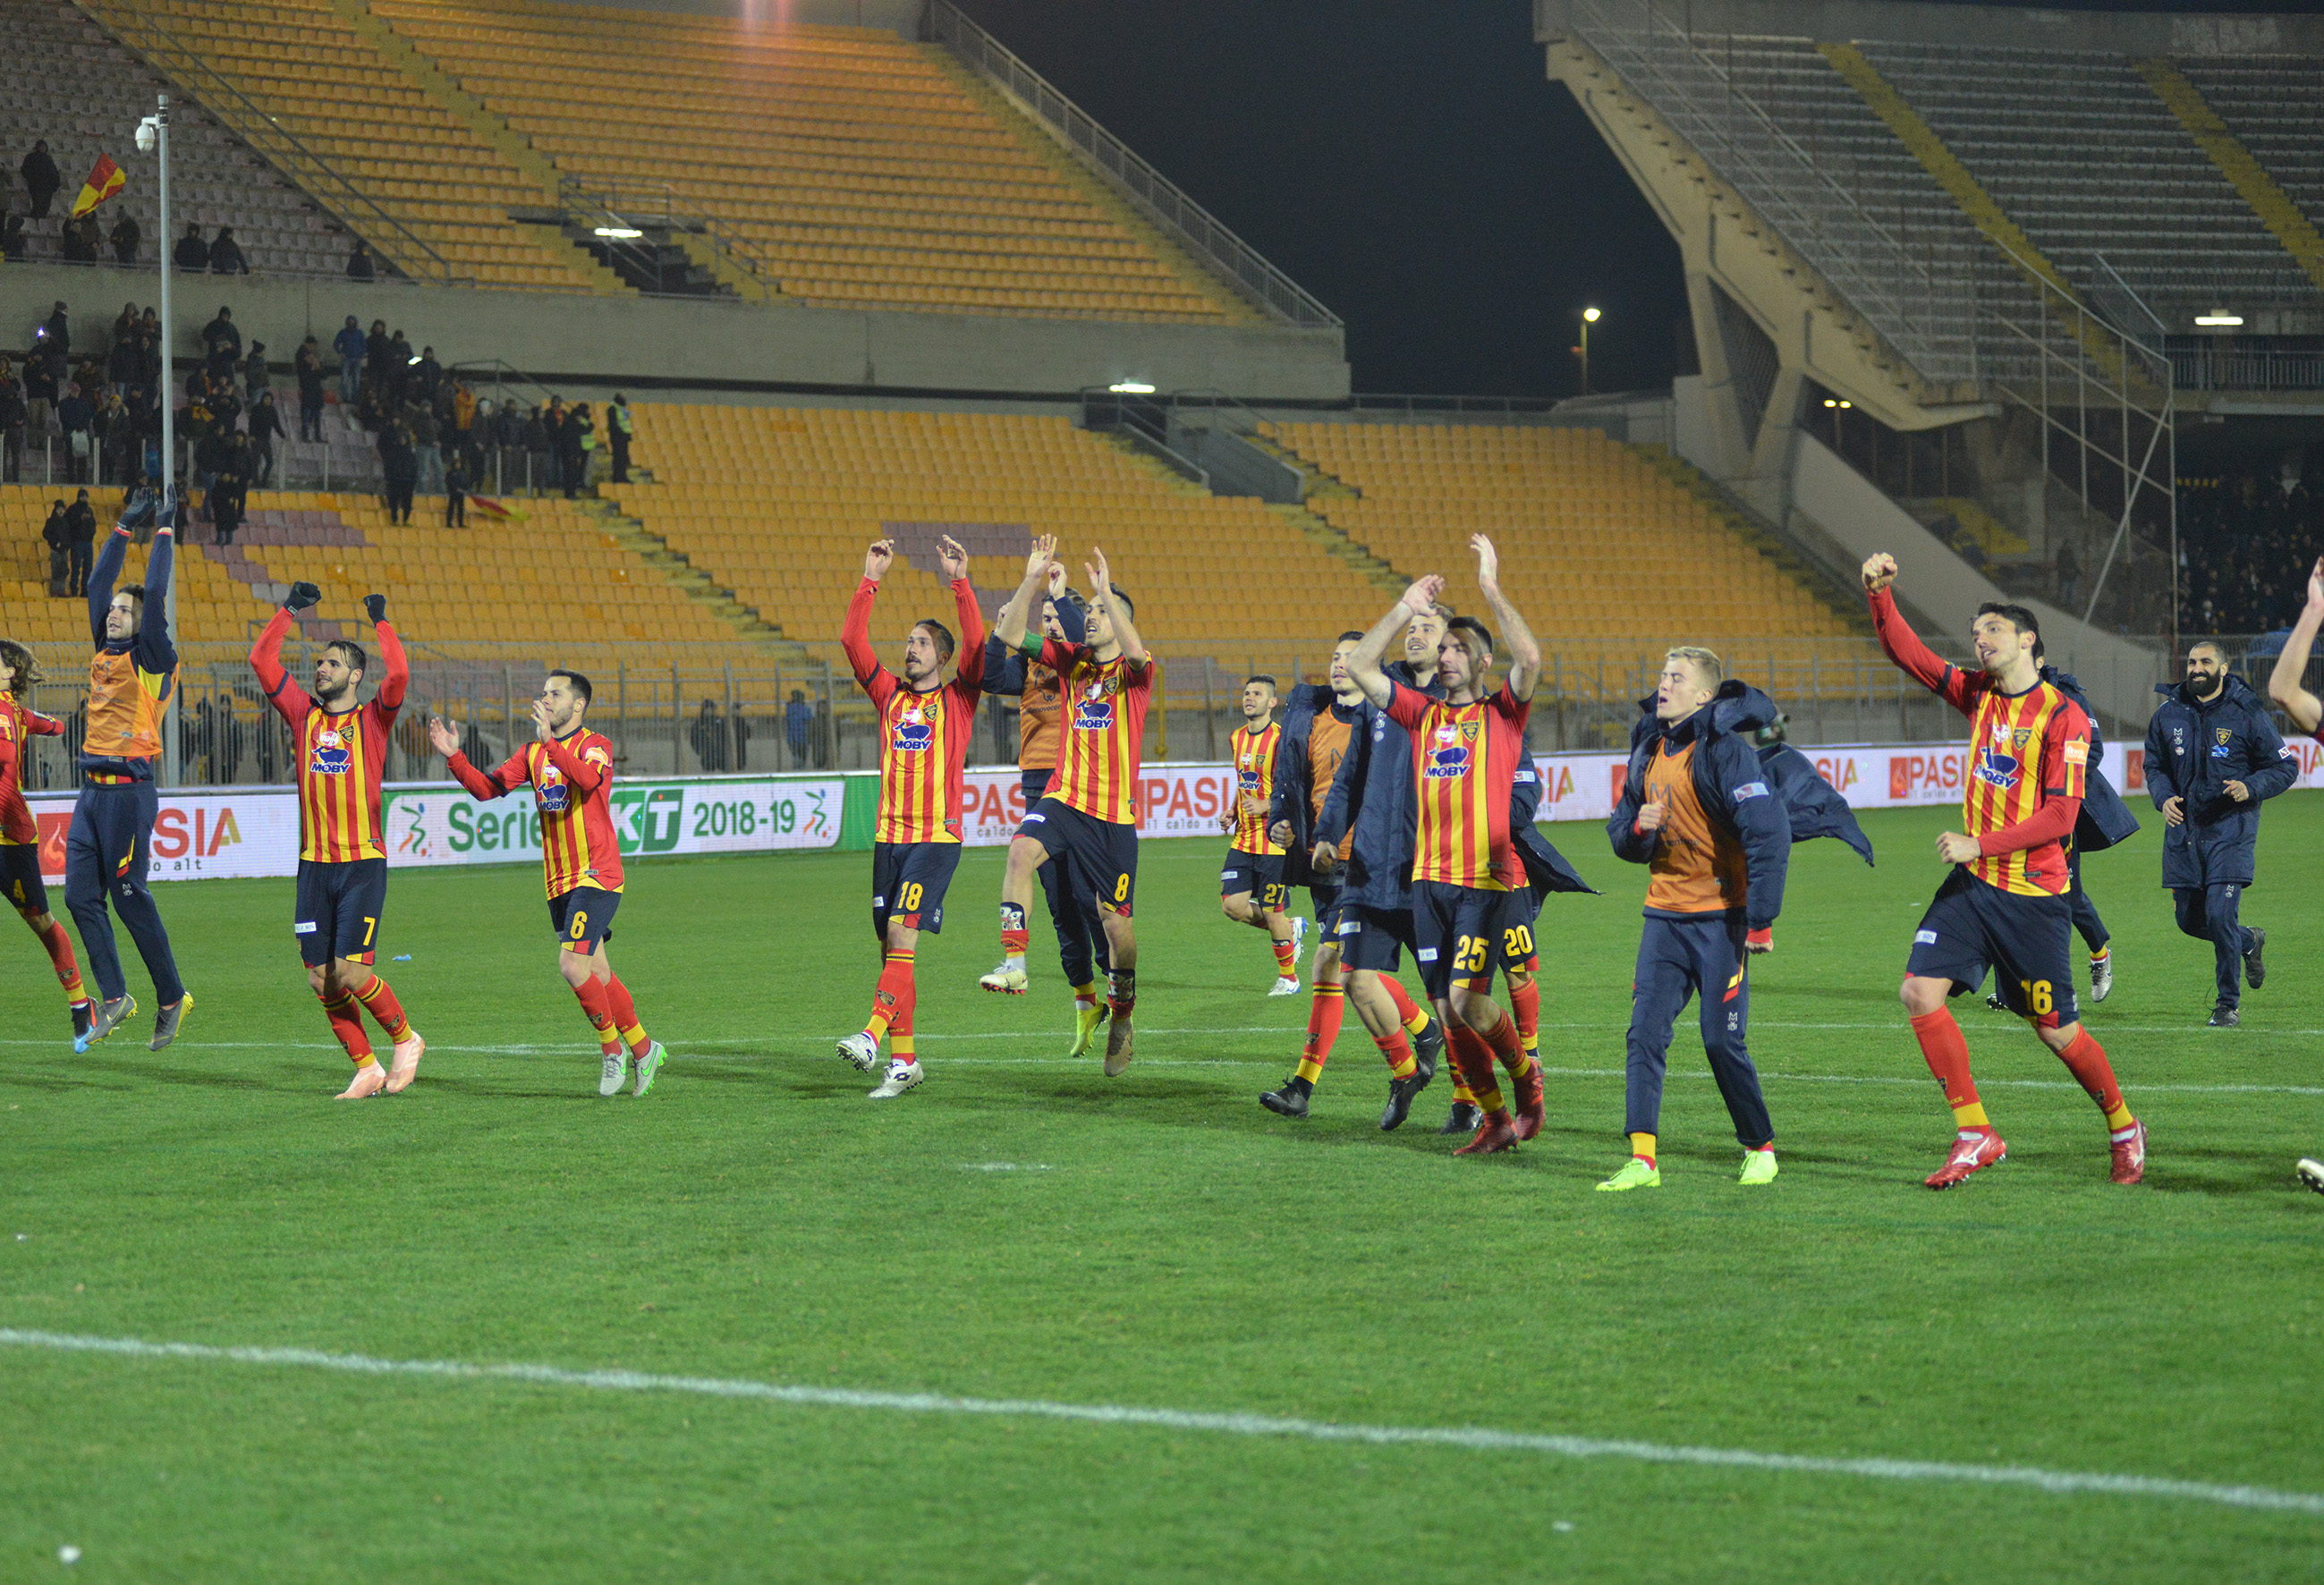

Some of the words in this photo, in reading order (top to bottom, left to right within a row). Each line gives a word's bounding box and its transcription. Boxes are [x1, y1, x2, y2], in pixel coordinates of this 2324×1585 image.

[1073, 718, 1114, 730] MOBY
[893, 740, 932, 750] MOBY
[2288, 744, 2324, 775] SIA
[310, 762, 352, 774] MOBY
[1424, 765, 1471, 778] MOBY
[1816, 758, 1858, 792] SIA
[1910, 755, 1965, 789] PASI
[1973, 764, 2019, 790] MOBY
[539, 800, 570, 810] MOBY
[963, 783, 1026, 826] PAS
[1147, 776, 1229, 818] PASI
[148, 808, 242, 859] SIA
[608, 798, 682, 844] KT
[693, 799, 795, 837] 2018-19
[978, 825, 1014, 837] caldo
[1166, 818, 1200, 829] caldo
[174, 858, 202, 871] alt
[897, 881, 923, 911] 18
[1115, 873, 1129, 902] 8
[1263, 883, 1285, 905] 27
[363, 916, 376, 946] 7
[570, 911, 588, 939] 6
[1453, 935, 1489, 972] 25
[1504, 925, 1533, 957] 20
[2021, 979, 2053, 1015] 16
